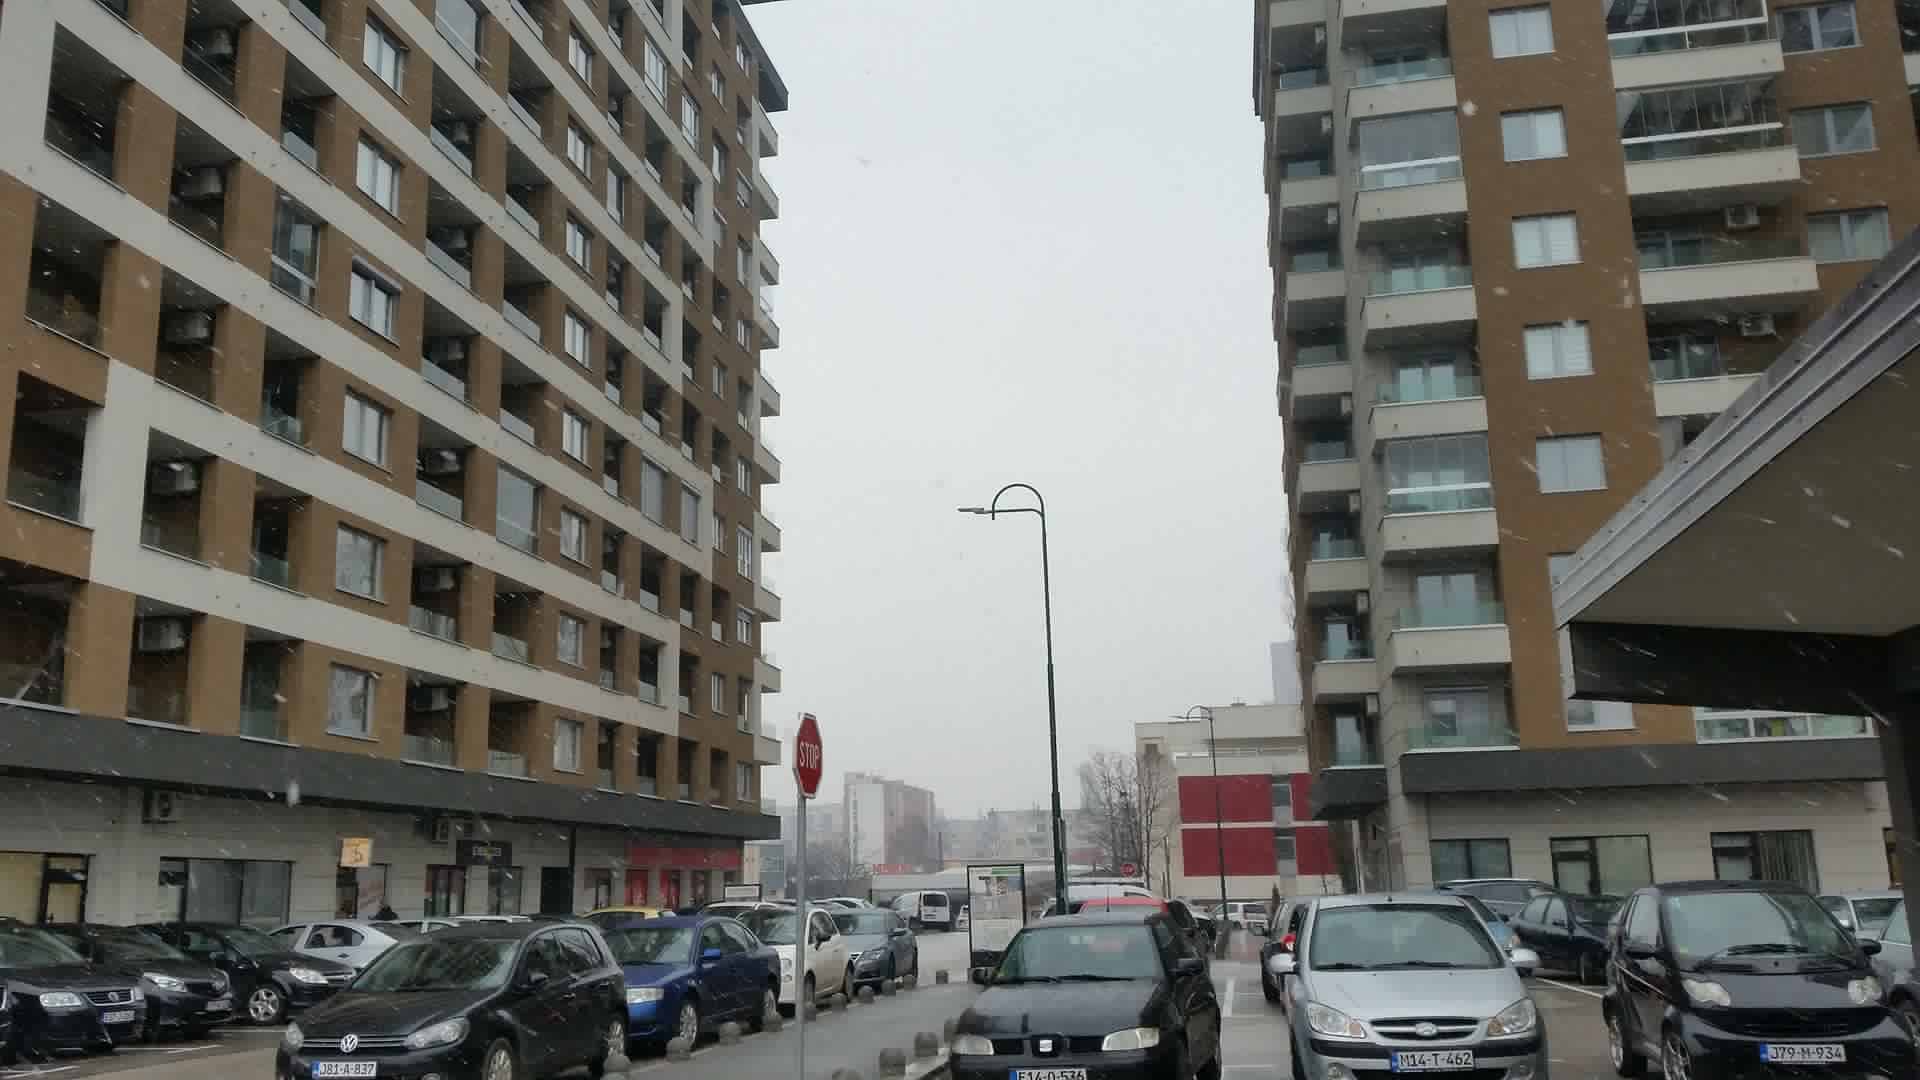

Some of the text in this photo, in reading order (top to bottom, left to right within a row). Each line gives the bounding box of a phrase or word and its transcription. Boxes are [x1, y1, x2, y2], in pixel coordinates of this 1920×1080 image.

[799, 740, 820, 769] STOP
[1400, 1052, 1472, 1067] M14-T-462
[1771, 1046, 1842, 1059] J79-M-934
[320, 1063, 375, 1076] J81-A-837
